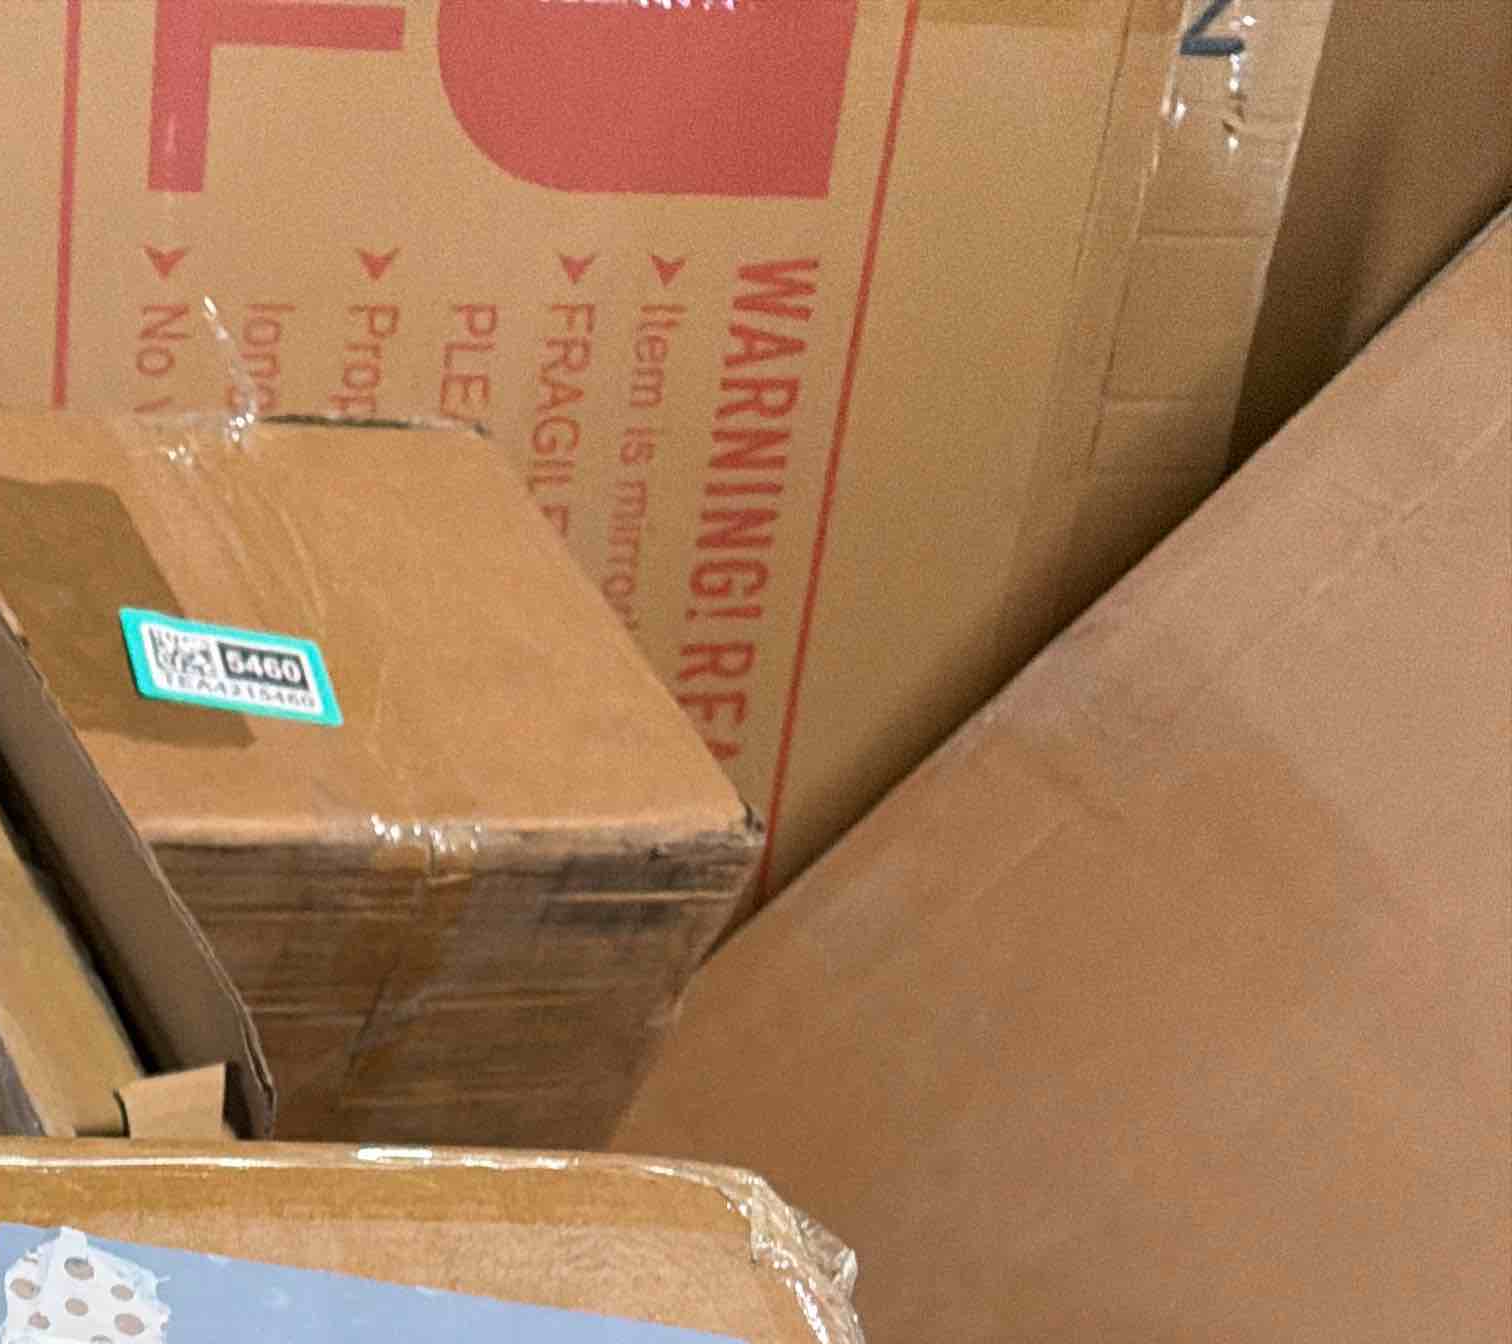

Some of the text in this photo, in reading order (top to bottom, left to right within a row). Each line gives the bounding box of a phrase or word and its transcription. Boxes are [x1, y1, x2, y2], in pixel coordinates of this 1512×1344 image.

[136, 303, 191, 379] No
[439, 303, 498, 424] PLE
[618, 424, 655, 466] is
[676, 257, 820, 761] WARNING! RE
[225, 651, 302, 682] 5460
